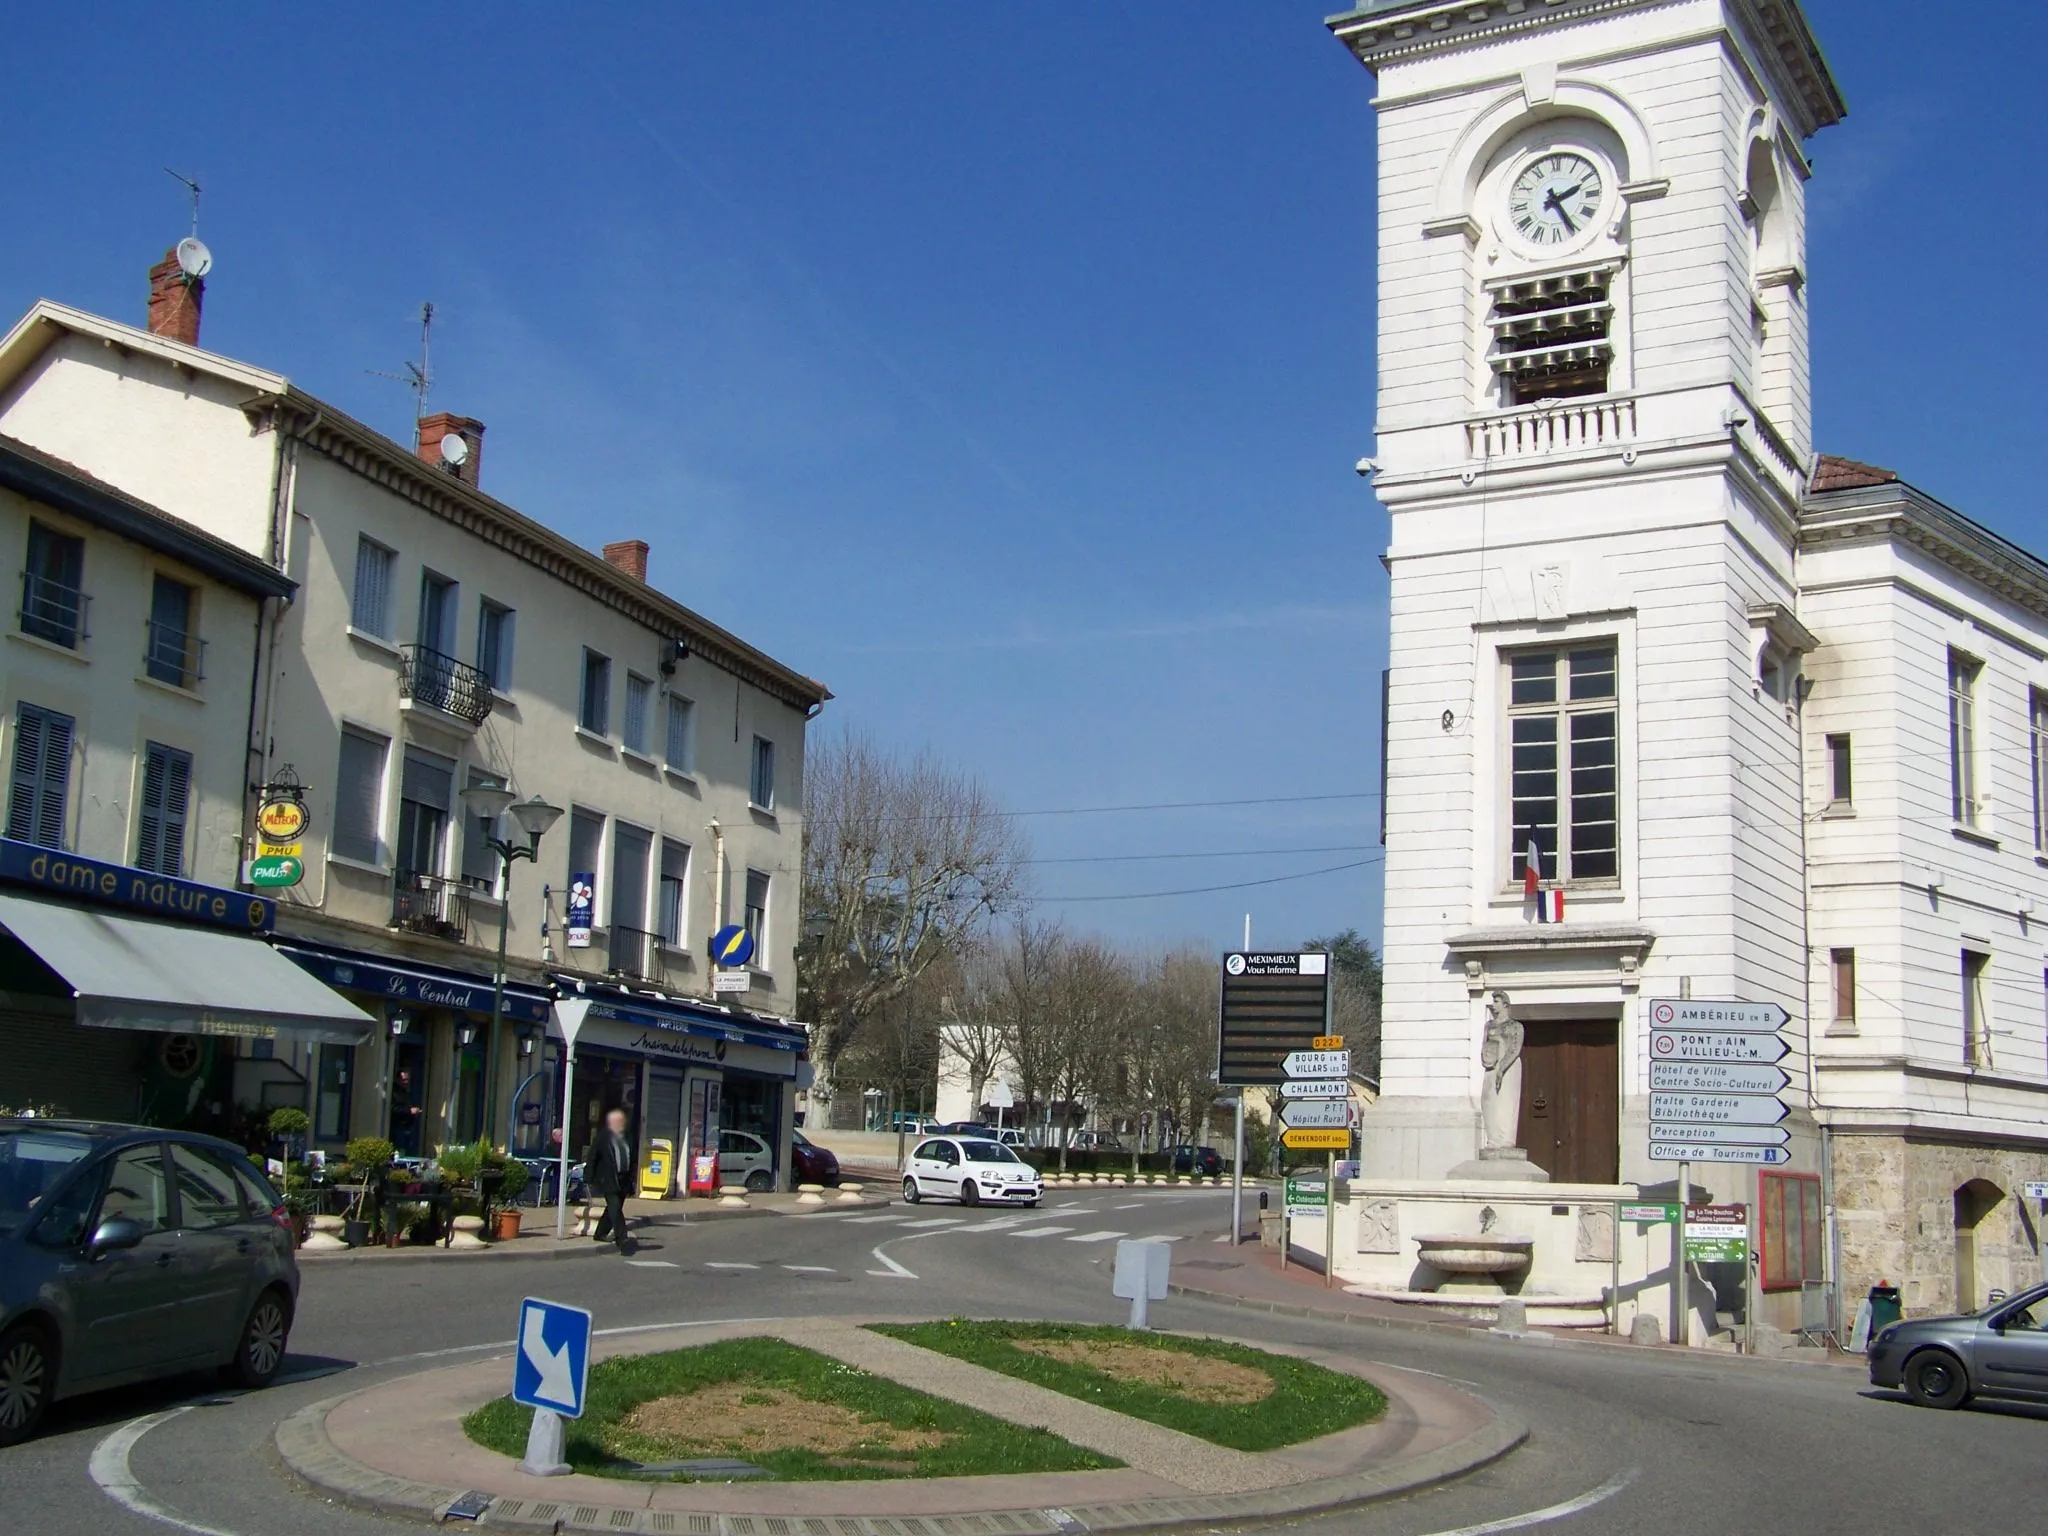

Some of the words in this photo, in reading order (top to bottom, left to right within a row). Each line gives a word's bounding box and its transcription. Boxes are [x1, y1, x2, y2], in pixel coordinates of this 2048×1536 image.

[266, 847, 294, 856] PMU
[254, 867, 280, 878] PMU
[31, 854, 118, 895] dame
[132, 878, 226, 917] nature
[1248, 955, 1296, 964] MEXIMIEUX
[1246, 966, 1265, 974] Vous
[1267, 966, 1297, 974] Informe
[387, 975, 407, 996] Le
[417, 980, 472, 1008] Central
[588, 1004, 617, 1020] BRAIRIE
[1681, 1009, 1745, 1021] AMBÉRIEU
[1681, 1035, 1712, 1045] PONT
[1295, 1054, 1326, 1062] BOURG
[1295, 1064, 1329, 1073] VILLARS
[1654, 1065, 1682, 1076] Hôtel
[1687, 1066, 1699, 1076] de
[1703, 1066, 1727, 1076] Ville
[1291, 1084, 1346, 1094] CHALAMONT
[1654, 1078, 1689, 1087] Centre
[1694, 1078, 1773, 1090] Socio-Culturel
[1654, 1096, 1684, 1106] Halte
[1691, 1097, 1740, 1108] Garderie
[1654, 1108, 1729, 1119] Bibliothèque
[1292, 1114, 1320, 1125] Hôpital
[1323, 1115, 1345, 1124] Rural
[1654, 1127, 1716, 1139] Perception
[1654, 1146, 1687, 1156] Office
[1691, 1148, 1705, 1157] de
[1713, 1148, 1760, 1159] Tourisme
